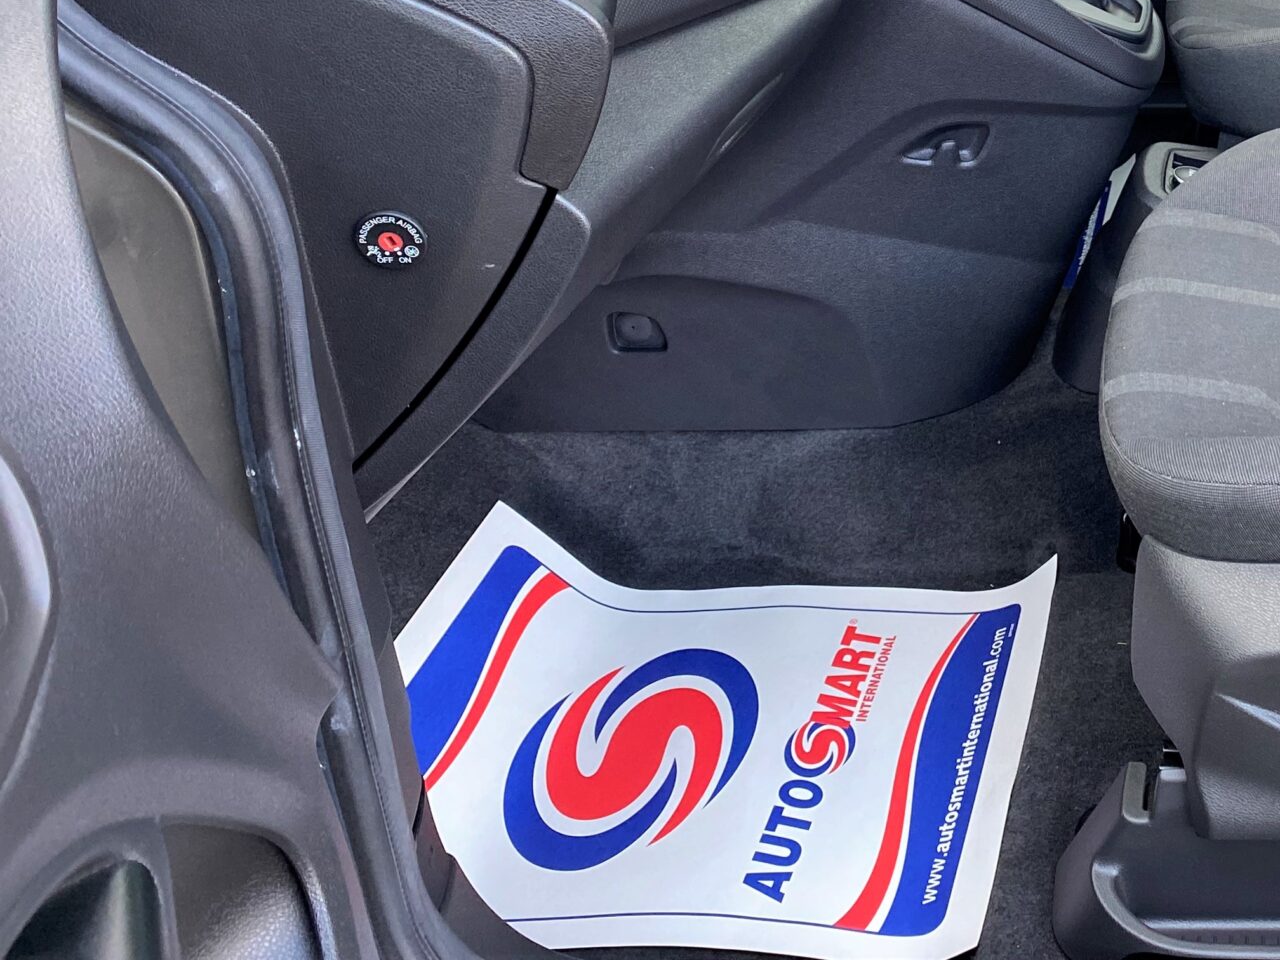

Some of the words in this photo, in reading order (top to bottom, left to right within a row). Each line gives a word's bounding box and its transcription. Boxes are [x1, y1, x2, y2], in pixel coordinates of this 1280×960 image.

[359, 216, 396, 244] PASSENGER
[396, 219, 423, 244] AIRBAG
[376, 256, 394, 264] OFF
[398, 256, 412, 264] ON
[856, 635, 897, 722] INTERNATIONAL
